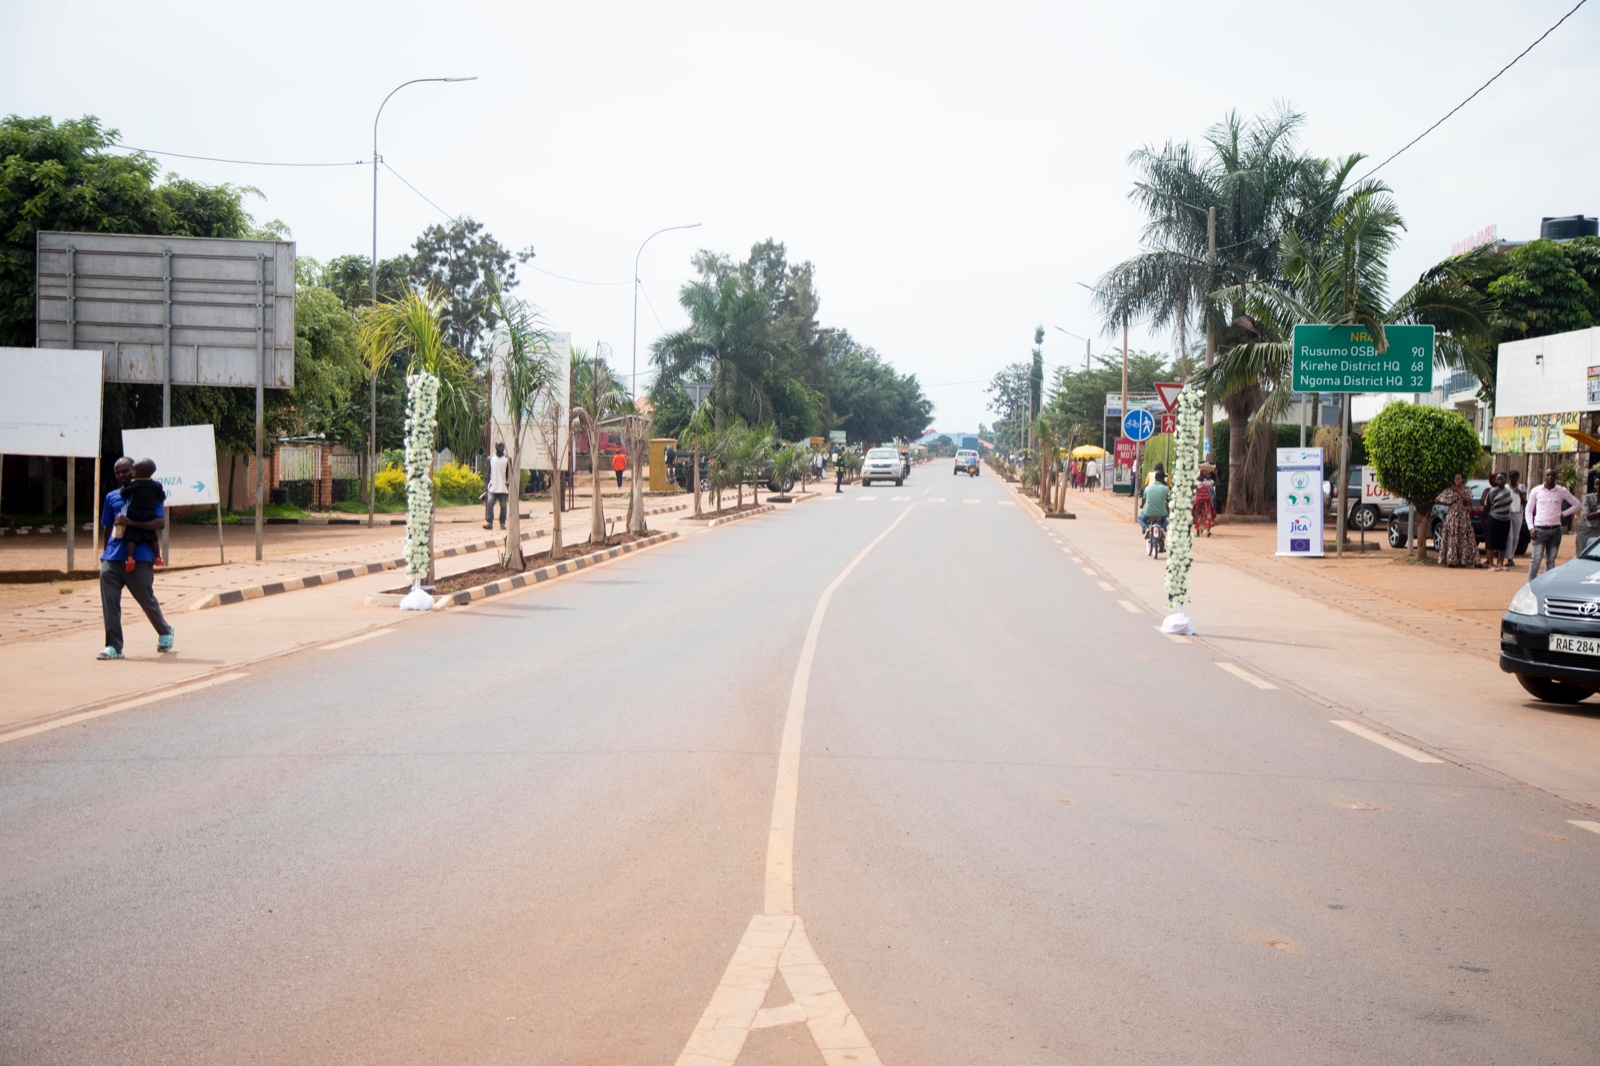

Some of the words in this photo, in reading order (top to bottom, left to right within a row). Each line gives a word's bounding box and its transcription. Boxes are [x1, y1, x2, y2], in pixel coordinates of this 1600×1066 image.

[1301, 346, 1348, 357] Rusumo
[1411, 347, 1425, 358] 90
[1300, 361, 1338, 372] Kirehe
[1340, 361, 1380, 372] District
[1383, 361, 1400, 372] HQ
[1410, 361, 1424, 372] 68
[1300, 375, 1341, 388] Ngoma
[1343, 375, 1384, 387] District
[1386, 376, 1403, 387] HQ
[1410, 375, 1424, 387] 32
[1513, 414, 1552, 428] PARADISE
[1556, 412, 1578, 426] PARK
[1117, 443, 1144, 452] MIDLAD
[1556, 637, 1574, 651] RAE
[1577, 640, 1594, 653] 284
